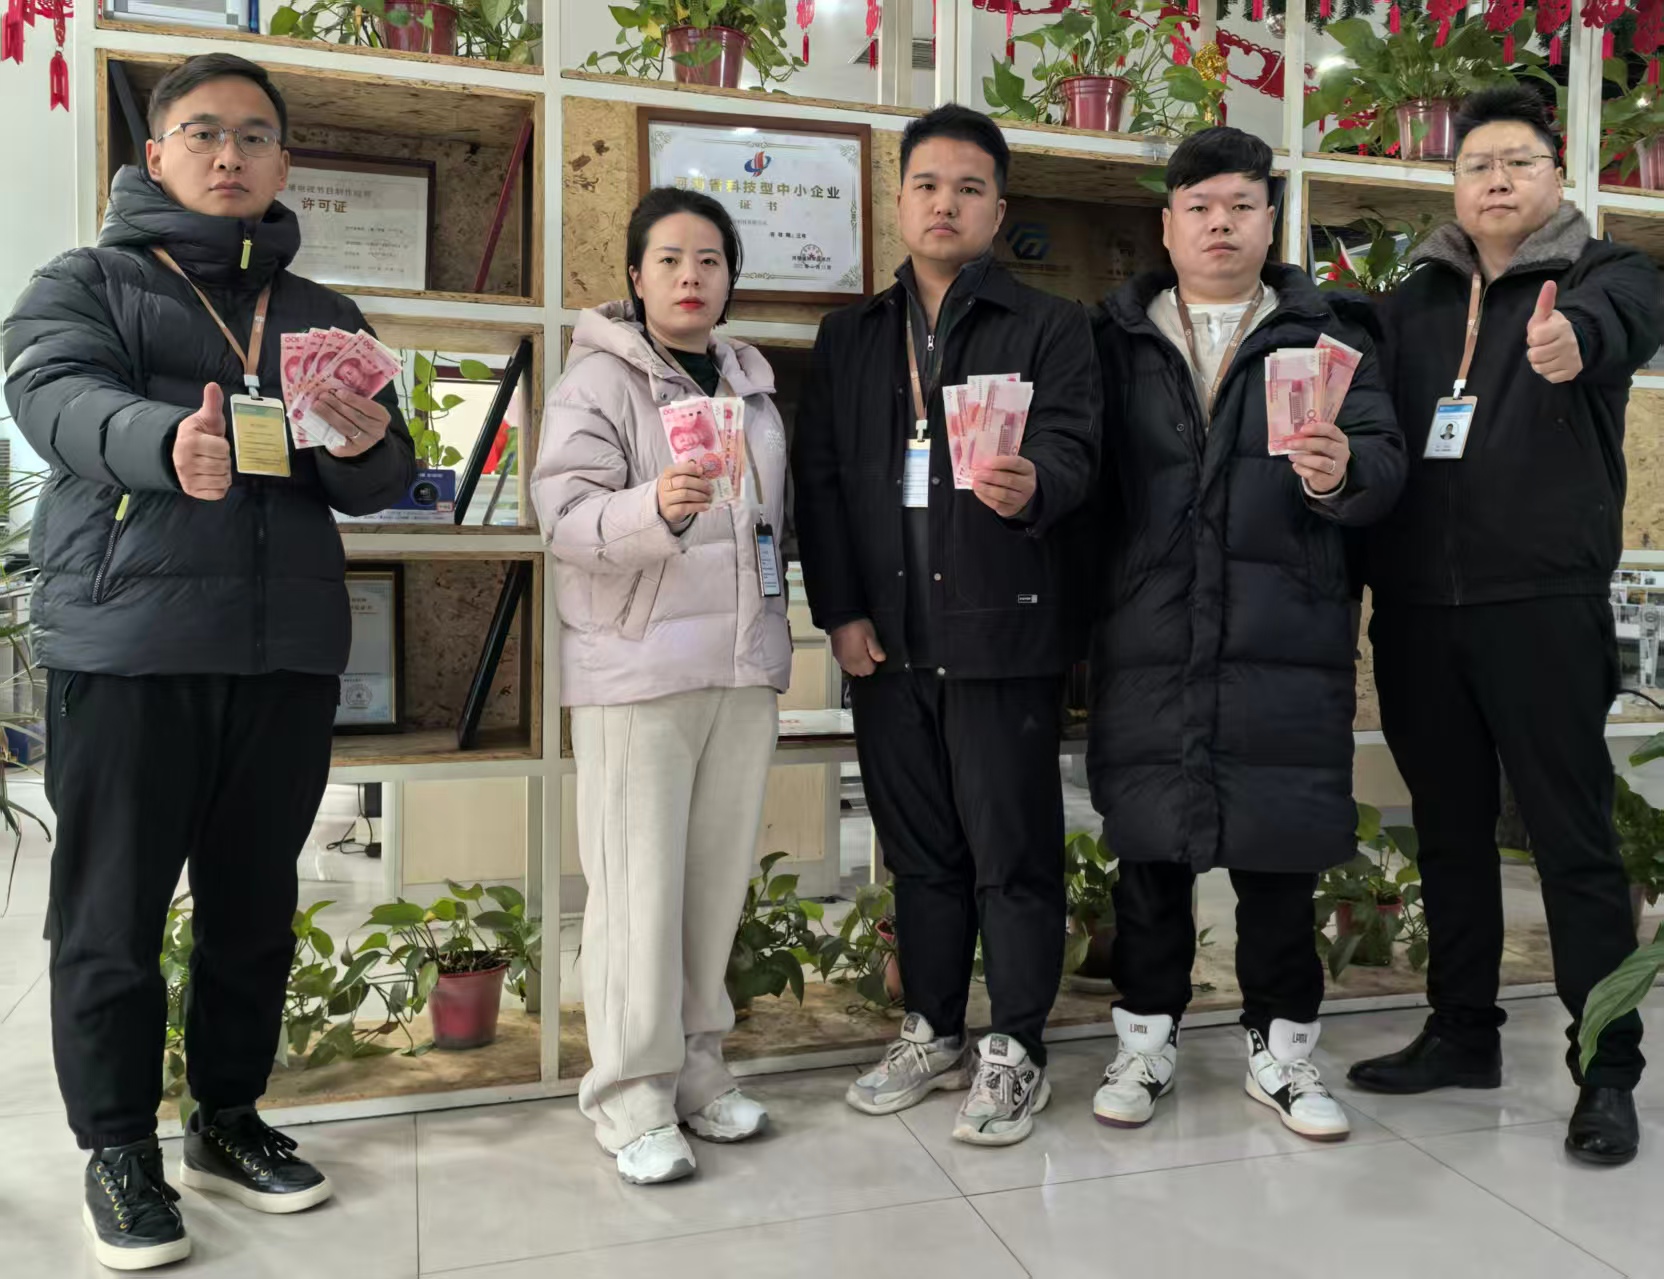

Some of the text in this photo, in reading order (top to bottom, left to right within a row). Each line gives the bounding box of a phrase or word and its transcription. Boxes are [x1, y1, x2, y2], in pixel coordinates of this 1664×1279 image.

[674, 176, 841, 200] 河南省科技型中小企业
[301, 197, 348, 214] 许可证
